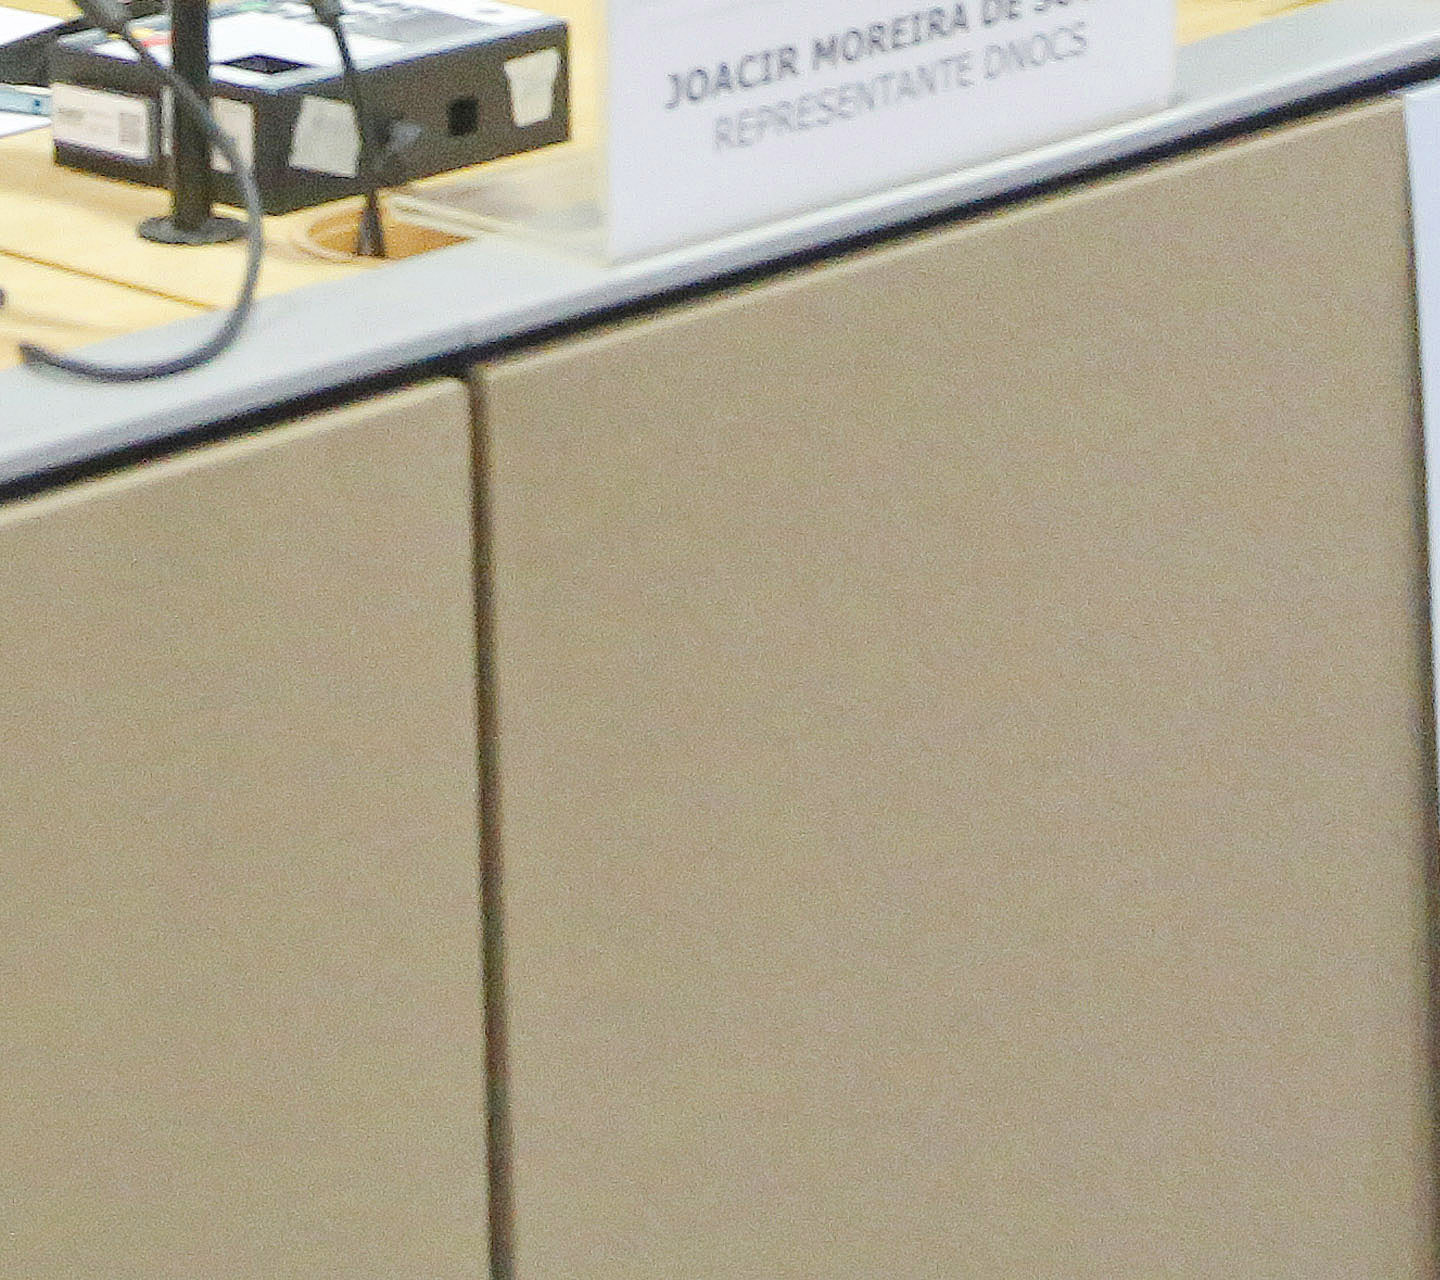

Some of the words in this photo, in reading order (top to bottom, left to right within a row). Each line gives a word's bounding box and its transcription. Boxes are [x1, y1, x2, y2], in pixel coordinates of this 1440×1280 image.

[665, 46, 800, 111] JOACIR
[811, 2, 970, 71] MOREIRA
[713, 51, 975, 151] REPRESENTANTE
[983, 21, 1089, 80] DNOCS
